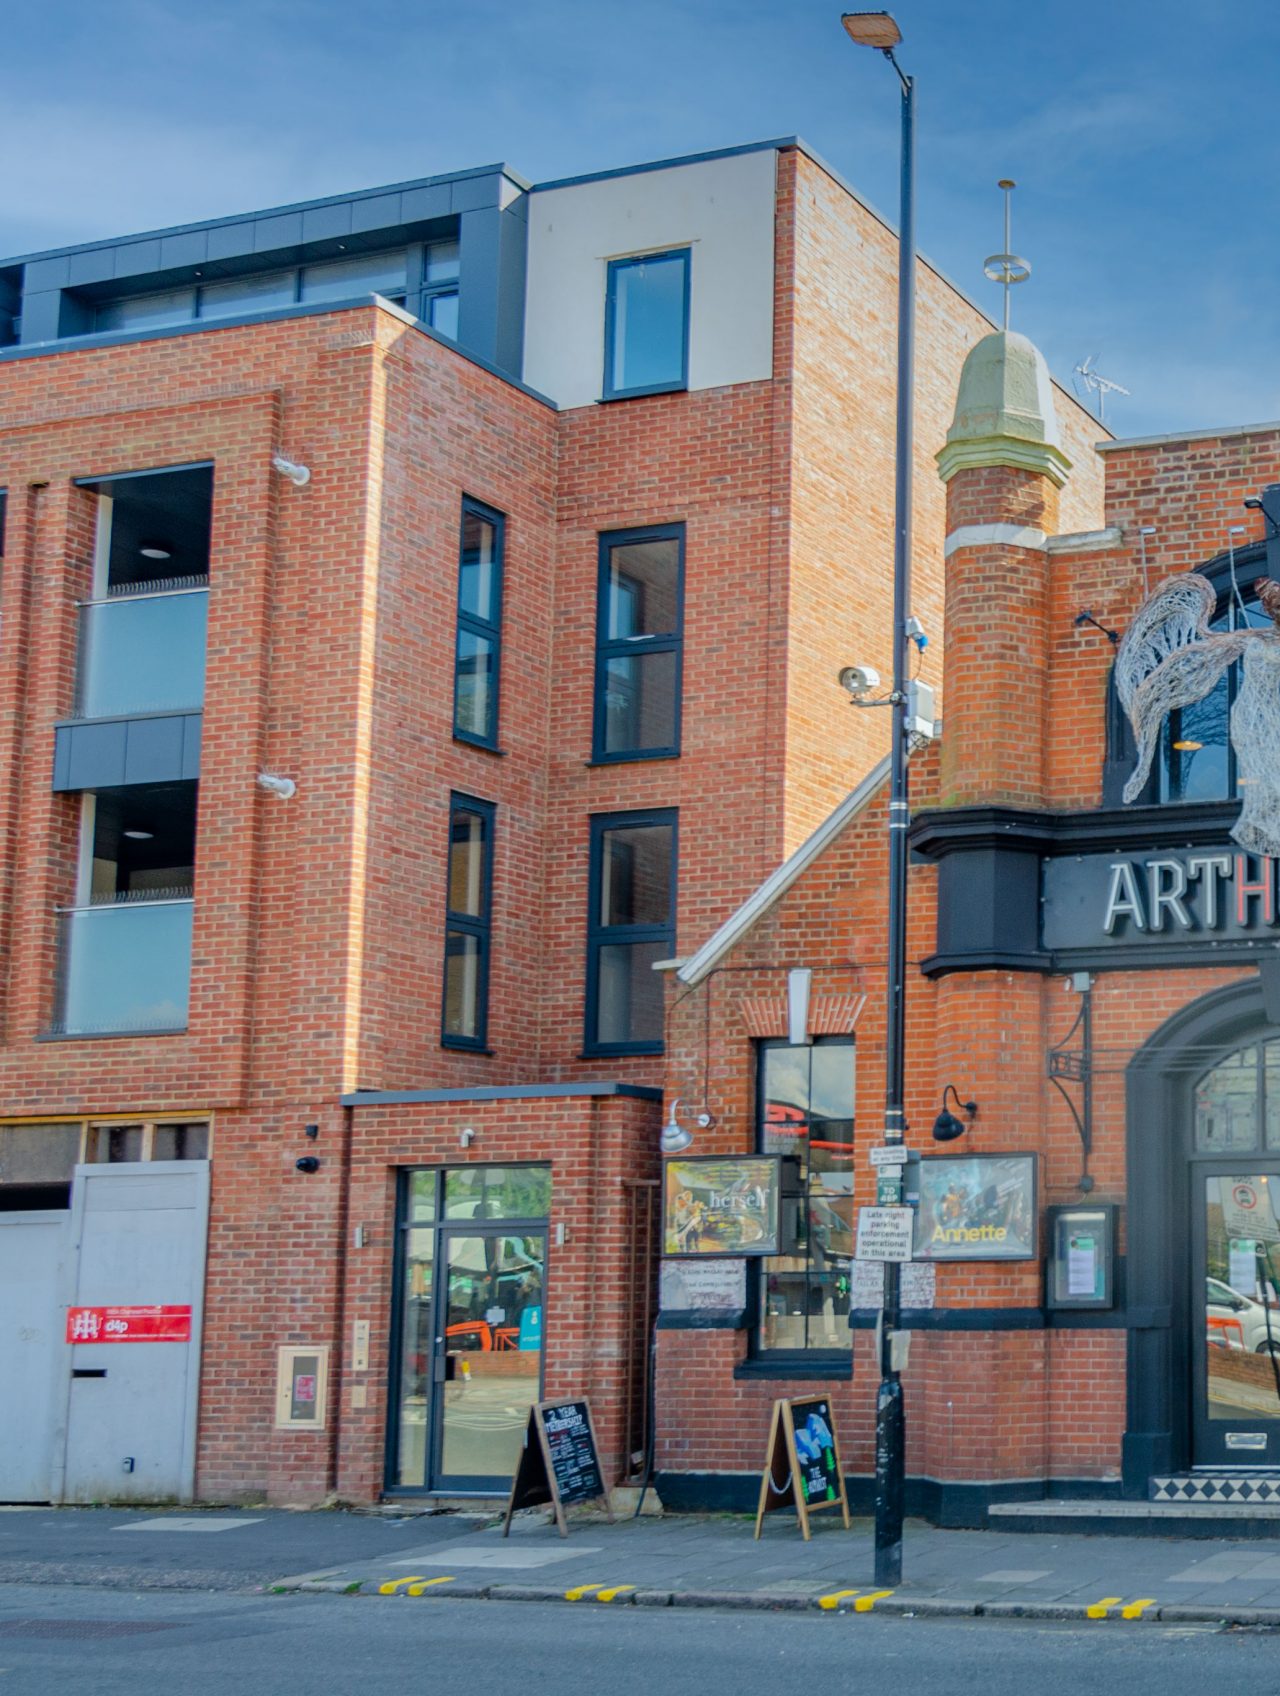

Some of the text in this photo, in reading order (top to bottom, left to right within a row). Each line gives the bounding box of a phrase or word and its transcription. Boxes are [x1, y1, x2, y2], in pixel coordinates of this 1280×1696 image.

[709, 1186, 770, 1209] herself
[885, 1211, 905, 1219] night
[870, 1220, 900, 1229] parking
[860, 1230, 910, 1238] enforcement
[931, 1223, 1008, 1243] Annette
[862, 1239, 907, 1248] operational
[861, 1248, 869, 1256] in
[870, 1248, 886, 1257] this
